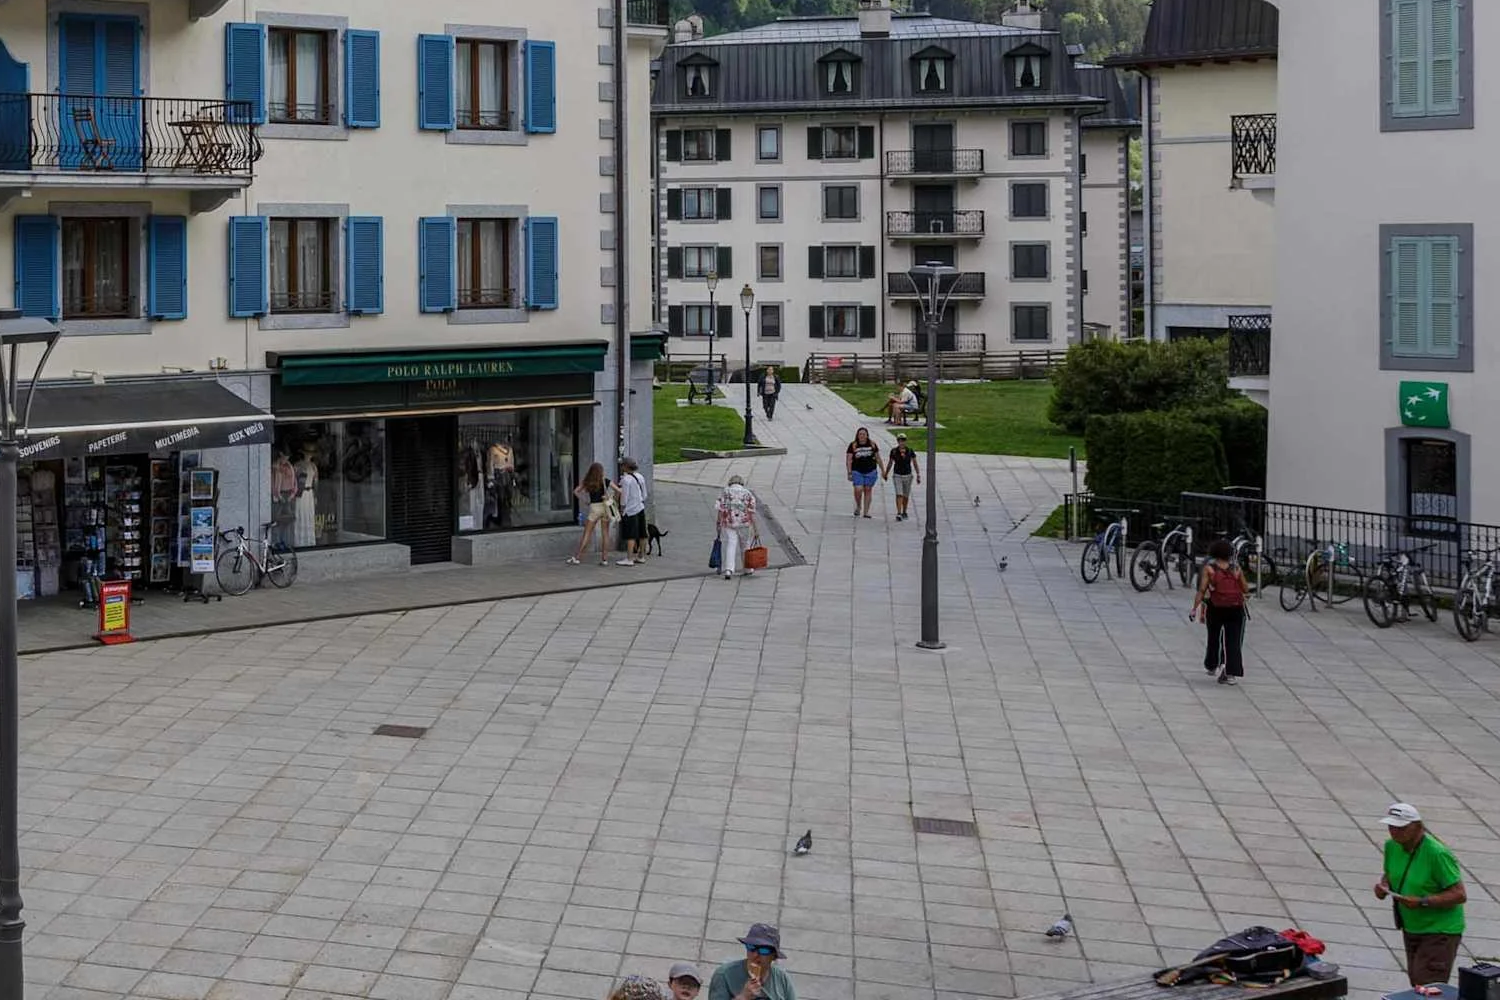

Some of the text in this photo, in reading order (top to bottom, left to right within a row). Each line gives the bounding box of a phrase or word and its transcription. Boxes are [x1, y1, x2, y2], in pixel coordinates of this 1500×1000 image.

[387, 361, 513, 377] POLO RALPH LAUREN
[19, 435, 61, 458] SOUVENIRS
[88, 431, 127, 453] PAPETERIE
[228, 431, 245, 444] JEUX
